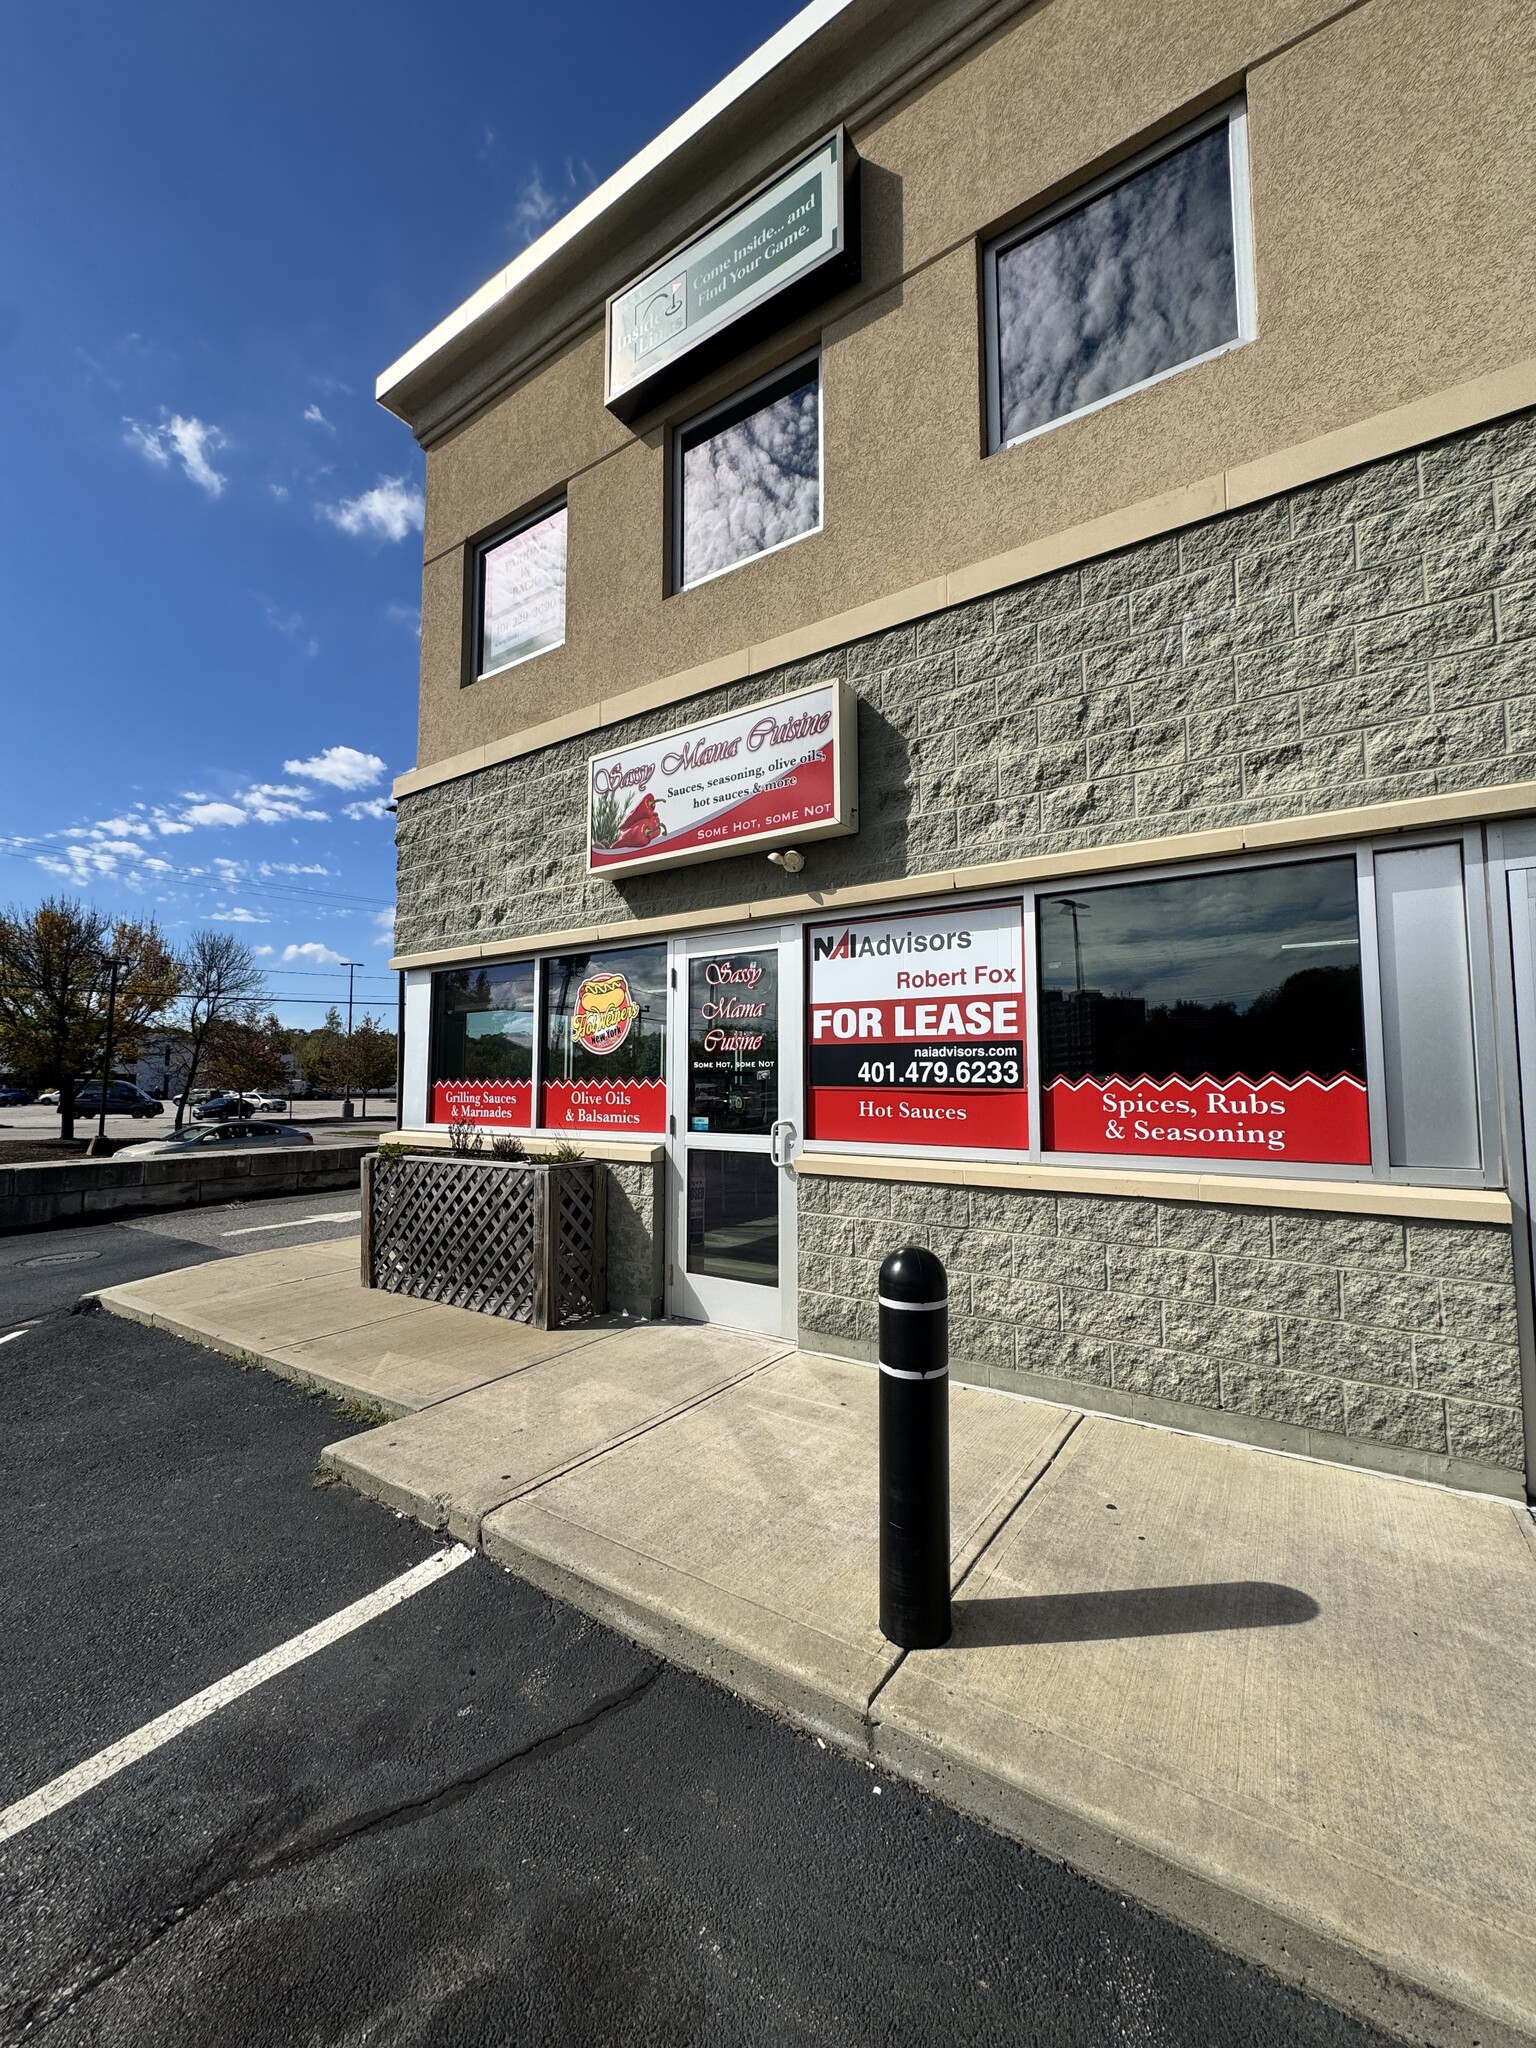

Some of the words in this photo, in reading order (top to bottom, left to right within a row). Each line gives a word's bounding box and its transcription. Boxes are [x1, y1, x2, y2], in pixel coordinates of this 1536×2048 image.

[693, 257, 731, 291] Come
[733, 223, 785, 263] Inside...
[787, 193, 815, 225] and
[698, 277, 727, 306] Find
[729, 255, 762, 284] Your
[764, 228, 810, 260] Game.
[617, 308, 663, 352] Inside
[593, 762, 655, 794] Sassy
[661, 737, 742, 776] Mama
[746, 710, 832, 752] Cuisine
[667, 781, 705, 798] Sauces,
[707, 766, 765, 788] seasoning,
[768, 757, 797, 773] olive
[799, 749, 826, 766] oils,
[693, 795, 710, 809] hot
[713, 787, 750, 803] sauces
[752, 783, 762, 794] &
[764, 775, 797, 792] more
[705, 961, 762, 989] Sassy
[897, 968, 967, 989] Robert
[975, 966, 1016, 985] Fox
[702, 997, 765, 1020] Mama
[813, 1007, 883, 1039] FOR
[895, 1001, 1018, 1037] LEASE
[591, 1033, 606, 1045] New
[606, 1025, 622, 1039] York
[704, 1029, 763, 1052] Cuisine
[914, 1046, 1017, 1058] naiadvisors.com
[858, 1061, 1019, 1084] 401.479.6233
[446, 1092, 481, 1106] Grilling
[483, 1092, 517, 1105] Sauces
[571, 1091, 602, 1105] Olive
[605, 1091, 631, 1105] Oils
[1102, 1092, 1197, 1118] Spices,
[1206, 1093, 1286, 1115] Rubs
[451, 1106, 459, 1117] &
[461, 1105, 512, 1119] Marinades
[565, 1110, 574, 1122] &
[577, 1109, 640, 1124] Balsamics
[859, 1101, 893, 1118] Hot
[899, 1102, 967, 1120] Sauces
[1105, 1120, 1126, 1140] &
[1134, 1120, 1285, 1151] Seasoning
